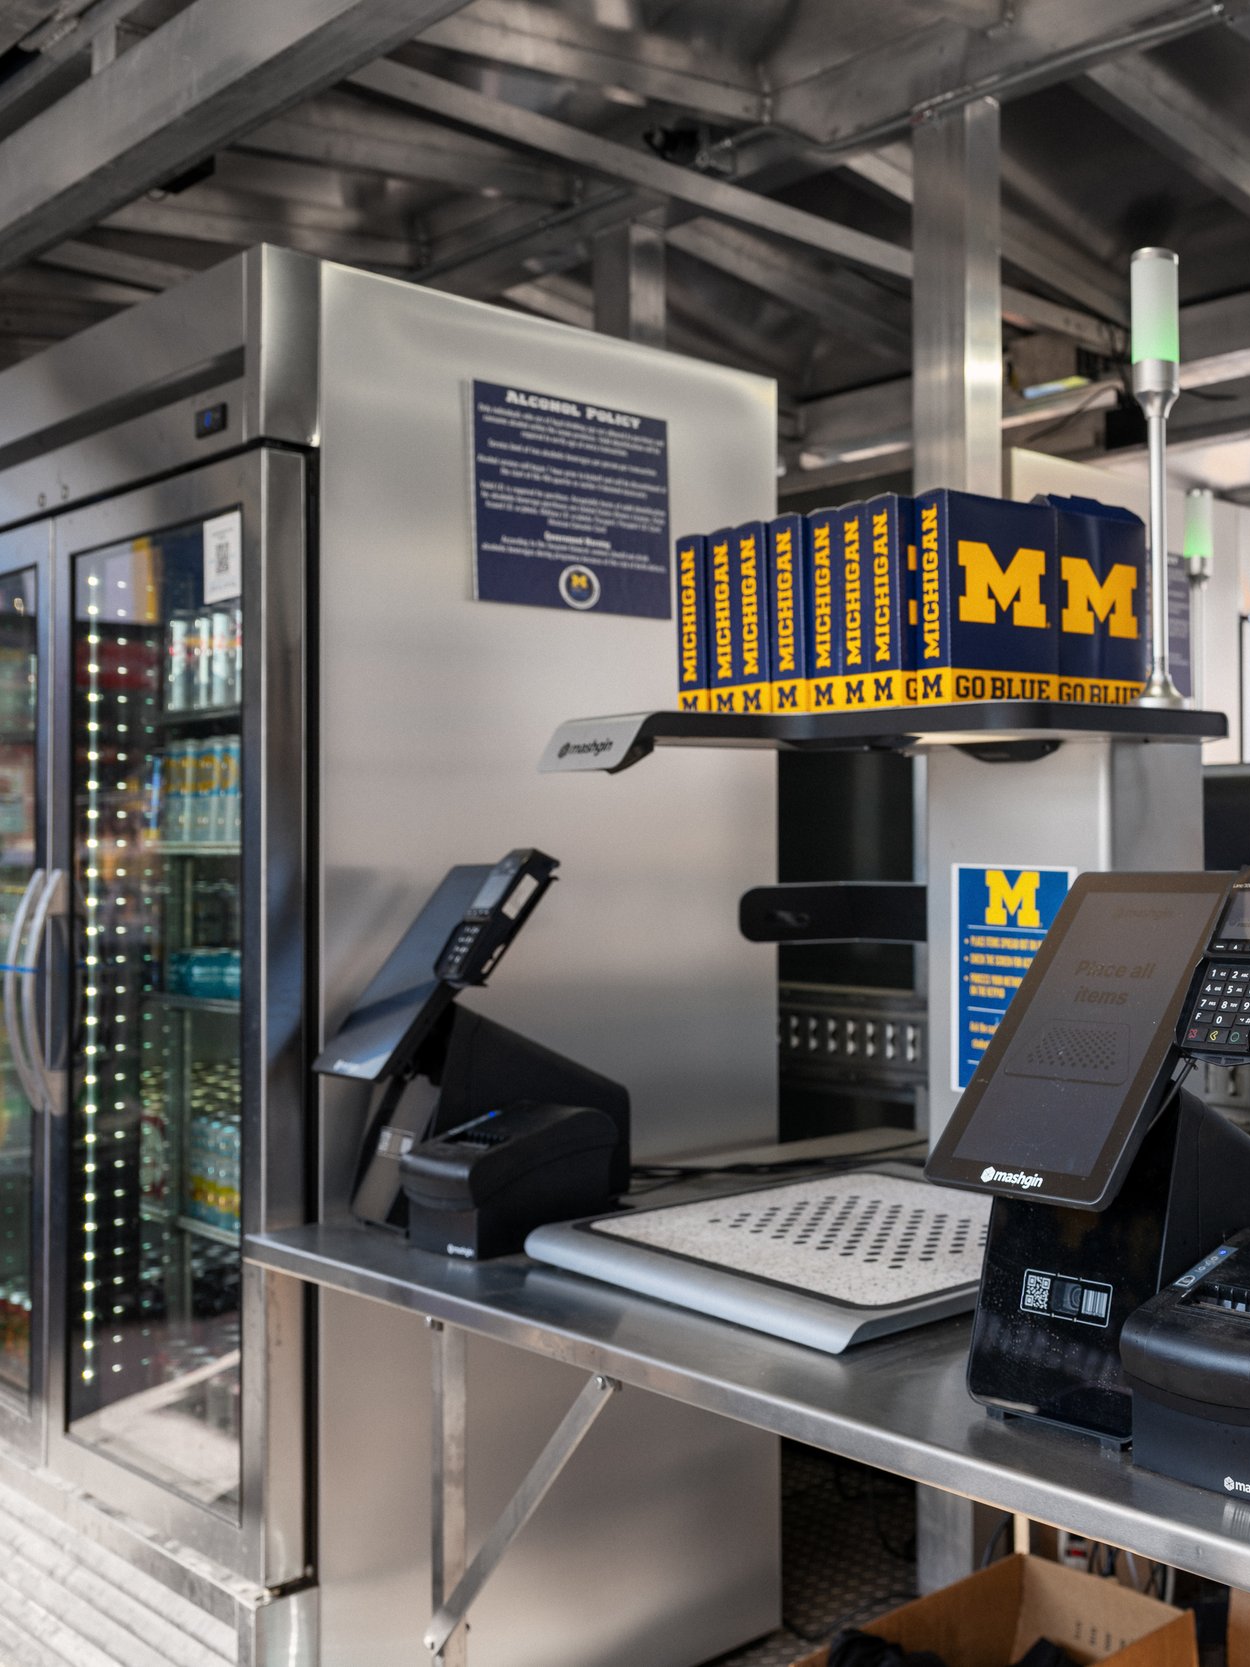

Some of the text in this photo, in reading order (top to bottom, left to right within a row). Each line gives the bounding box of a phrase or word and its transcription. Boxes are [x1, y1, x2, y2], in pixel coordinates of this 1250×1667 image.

[505, 390, 582, 417] ALCOHOL
[585, 406, 642, 429] POLICY
[844, 518, 862, 666] MICHIGAN
[873, 510, 890, 662] MICHIGAN
[921, 505, 940, 660] MICHIGAN
[957, 540, 1046, 628] M
[740, 537, 759, 675] MICHIGAN
[776, 530, 795, 672] MICHIGAN
[814, 524, 831, 669] MICHIGAN
[1061, 555, 1138, 639] M
[680, 549, 697, 682] MICHIGAN
[713, 542, 732, 679] MICHIGAN
[778, 685, 797, 709] M
[814, 683, 834, 706] M
[845, 680, 864, 704] M
[874, 677, 893, 701] M
[922, 674, 942, 699] M
[956, 675, 1050, 700] GO BLUE
[1058, 682, 1085, 702] GO
[682, 696, 698, 711] M
[717, 693, 734, 712] M
[743, 689, 761, 711] M
[985, 869, 1040, 927] M
[1074, 960, 1156, 978] Place all
[1212, 969, 1217, 977] 1
[1232, 971, 1238, 979] 2
[1073, 985, 1128, 1005] items
[1205, 984, 1211, 992] 4
[1227, 986, 1233, 994] 5
[1200, 999, 1207, 1007] 7
[1221, 1001, 1228, 1009] 8
[1243, 1002, 1250, 1010] 9
[1195, 1012, 1202, 1020] F
[1216, 1016, 1222, 1024] 0
[993, 1171, 1043, 1189] mashgin
